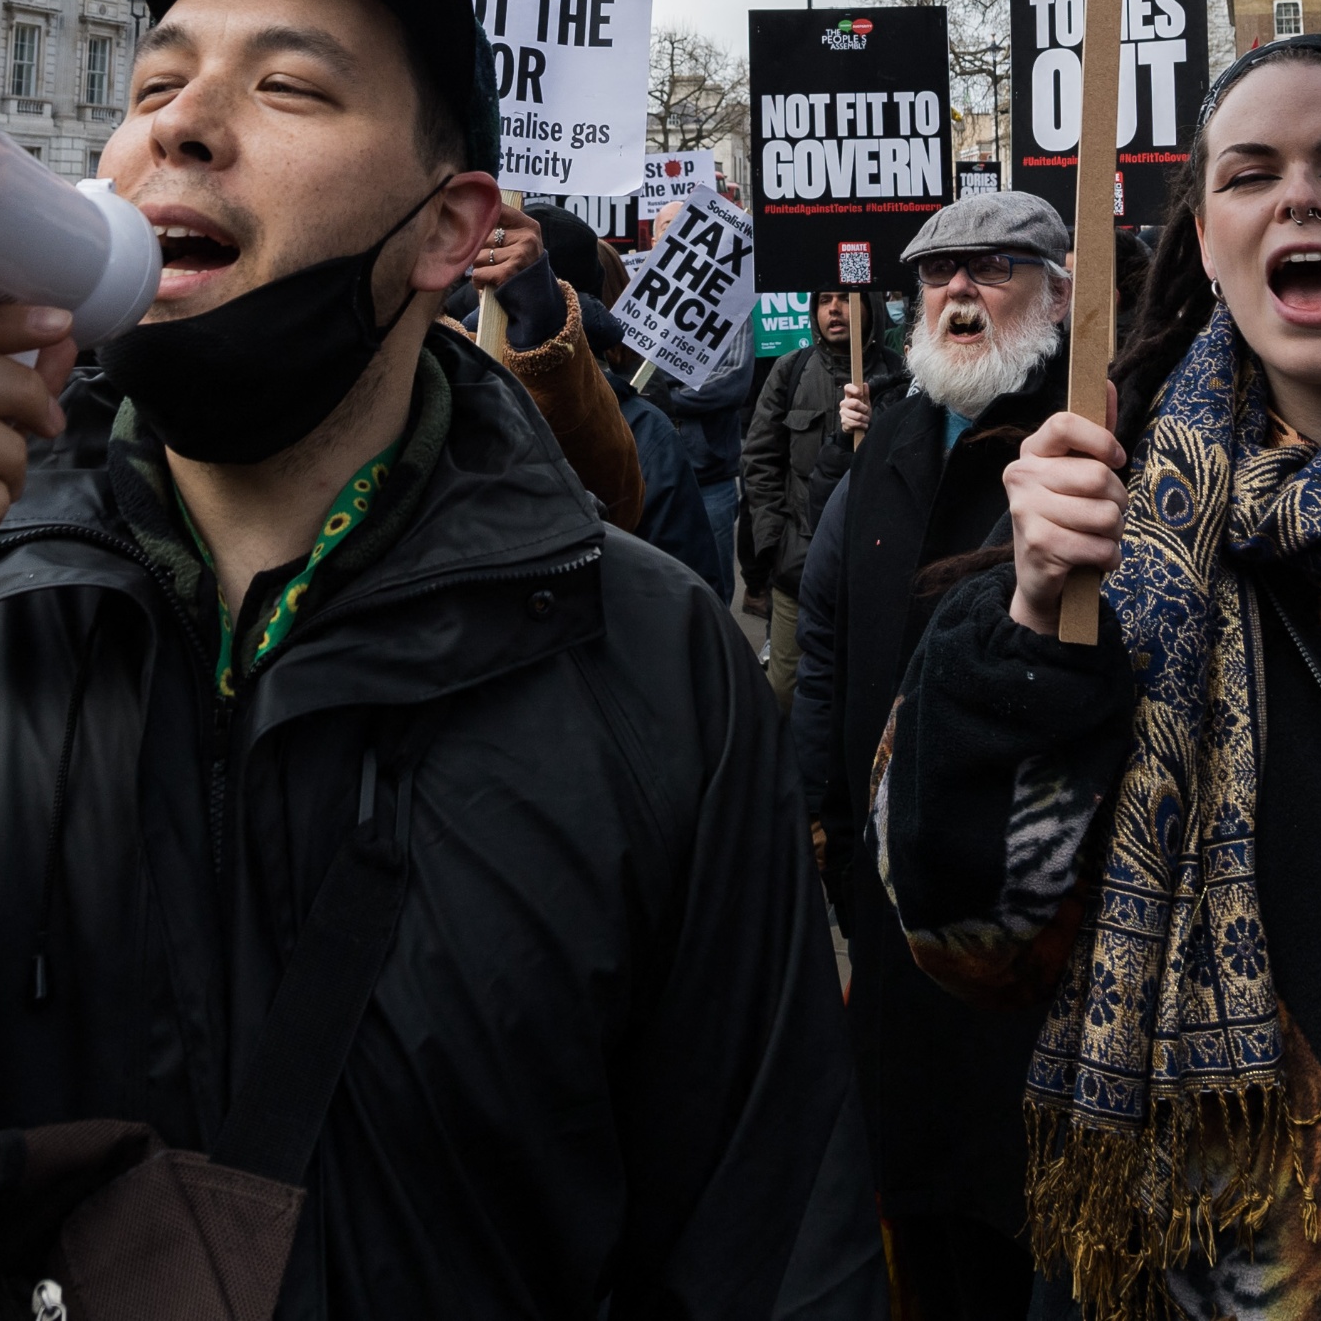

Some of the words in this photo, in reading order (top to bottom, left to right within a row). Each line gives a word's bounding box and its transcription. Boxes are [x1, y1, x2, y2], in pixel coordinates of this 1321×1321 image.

[493, 42, 547, 104] OR
[1032, 39, 1187, 152] OT
[500, 111, 563, 142] nalise
[570, 122, 610, 150] gas
[761, 93, 831, 139] NOT
[836, 92, 888, 137] FIT
[893, 90, 940, 136] TO
[640, 181, 666, 198] he
[762, 137, 943, 200] GOVERN
[959, 172, 998, 187] TORIES
[764, 203, 863, 215] #UnitedAgainstTories
[678, 204, 753, 278] TAX
[656, 234, 735, 308] THE
[621, 299, 641, 319] No
[643, 313, 658, 331] to
[659, 328, 670, 340] a
[670, 335, 696, 356] rise
[695, 348, 710, 365] in
[631, 268, 734, 352] RICH
[761, 314, 811, 332] WELF
[655, 346, 695, 376] prices
